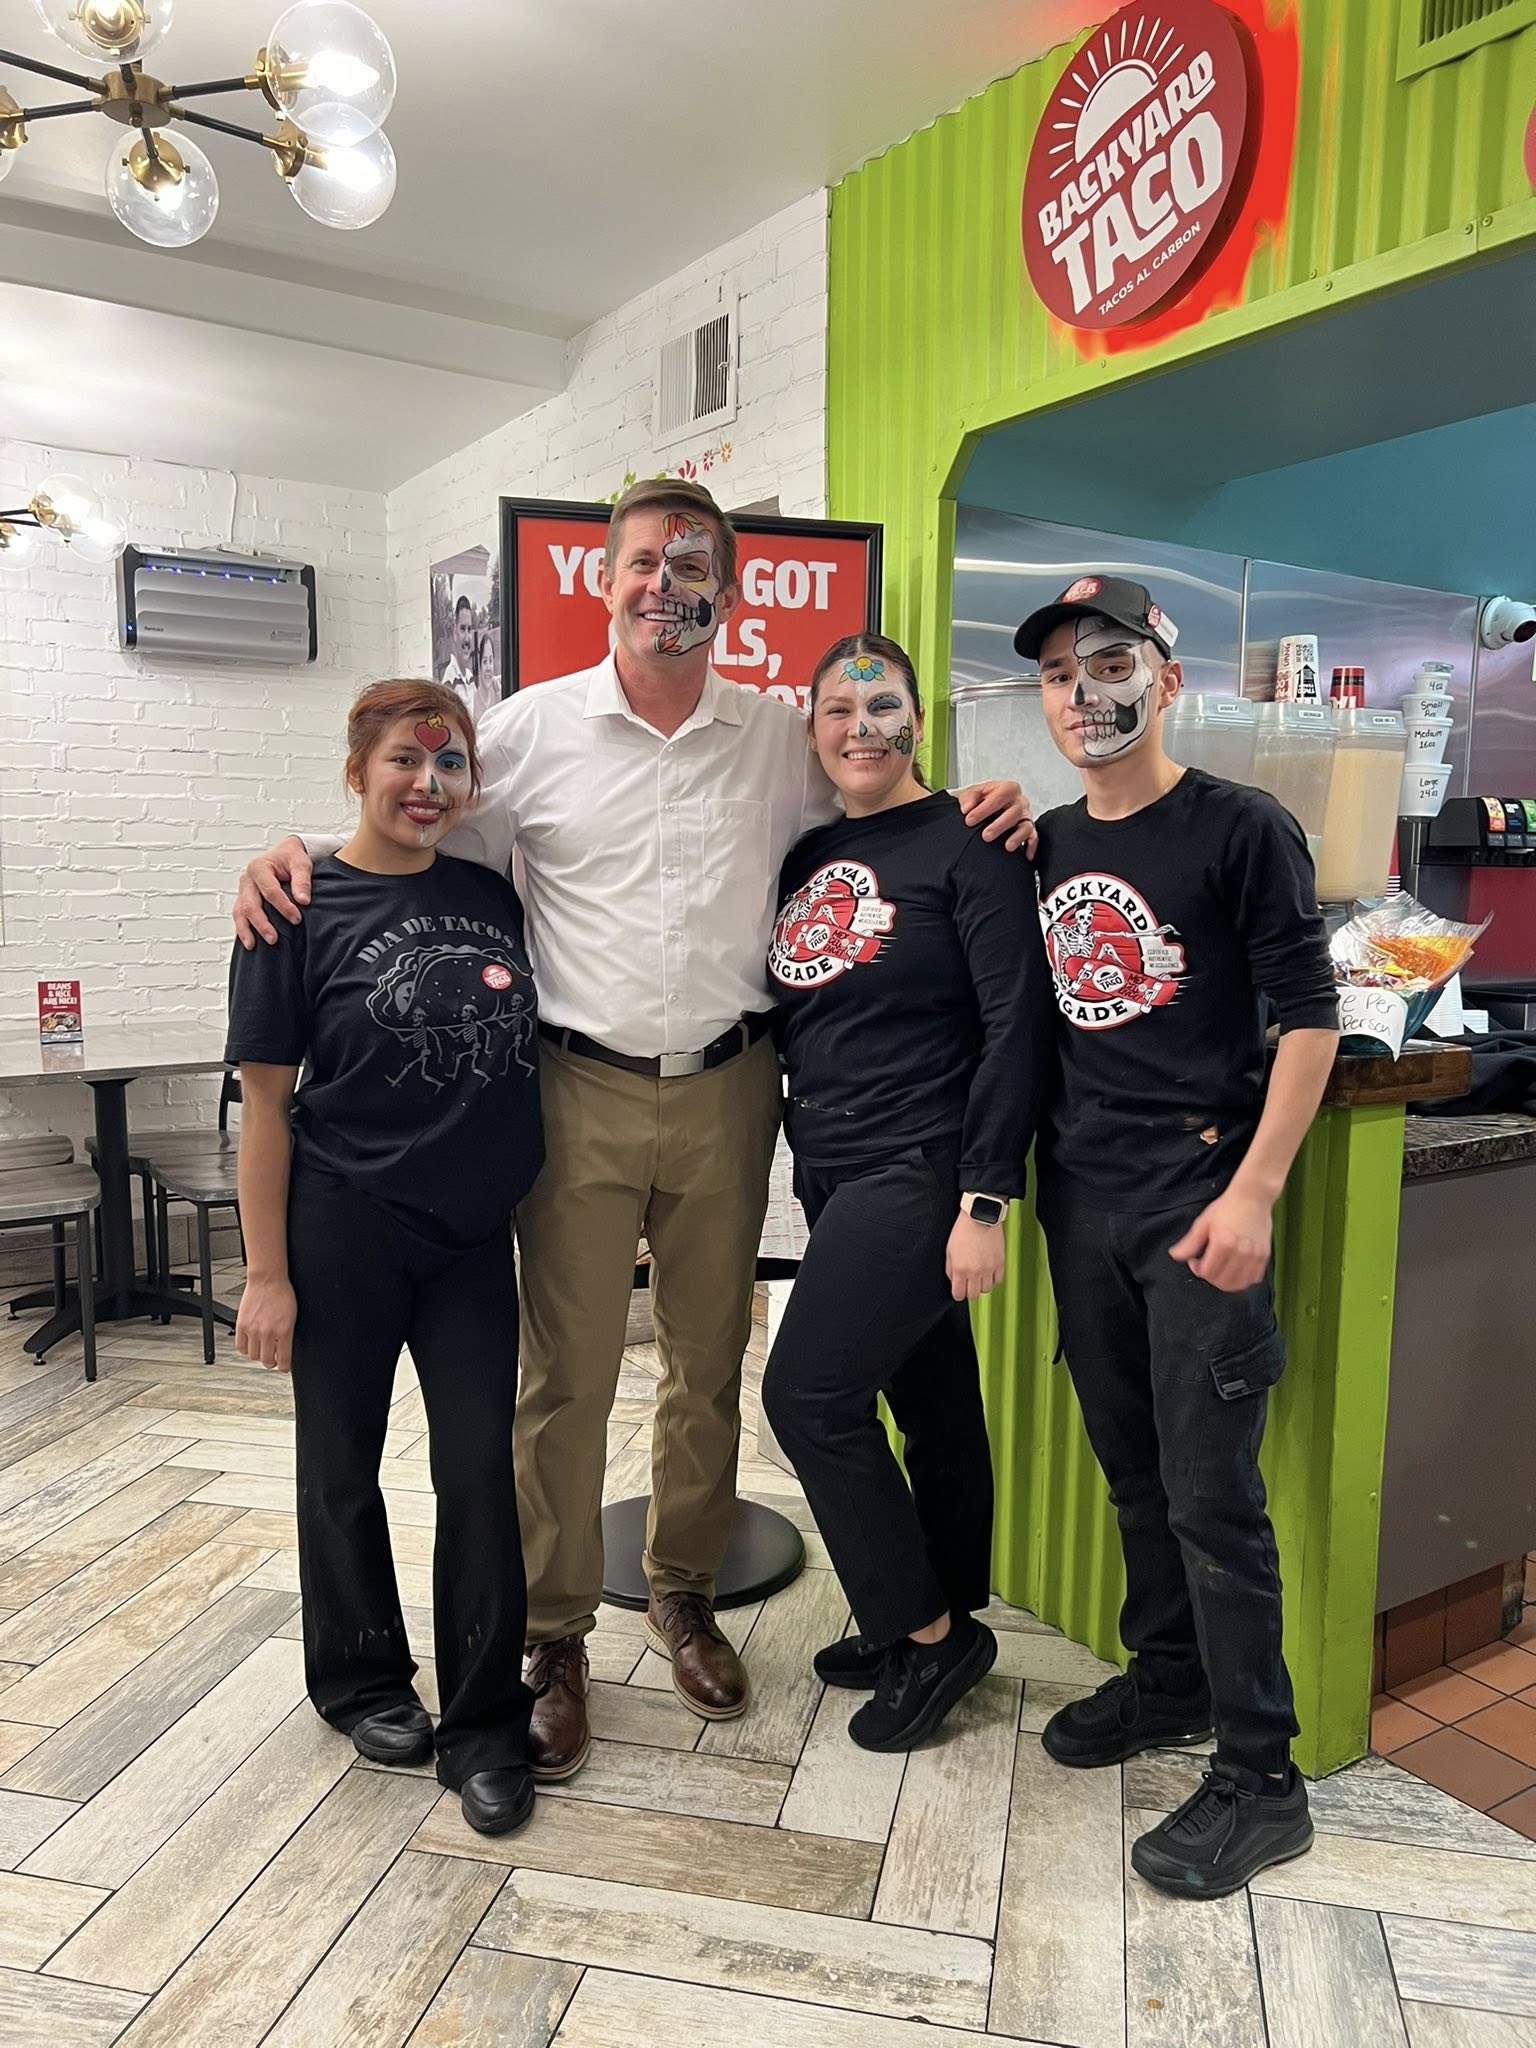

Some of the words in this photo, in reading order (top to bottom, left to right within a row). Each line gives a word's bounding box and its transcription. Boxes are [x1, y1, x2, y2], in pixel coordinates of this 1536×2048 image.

[1037, 51, 1216, 247] BACKYARD
[1051, 111, 1223, 315] TACO
[1099, 280, 1134, 315] TACOS
[1136, 268, 1152, 285] AL
[1152, 220, 1201, 270] CARBON
[742, 558, 838, 610] GOT
[1420, 700, 1443, 711] Small
[1419, 778, 1440, 789] Large
[356, 931, 404, 964] DIA
[402, 916, 436, 936] DE
[440, 916, 516, 949] TACOS
[1099, 976, 1123, 990] TACO
